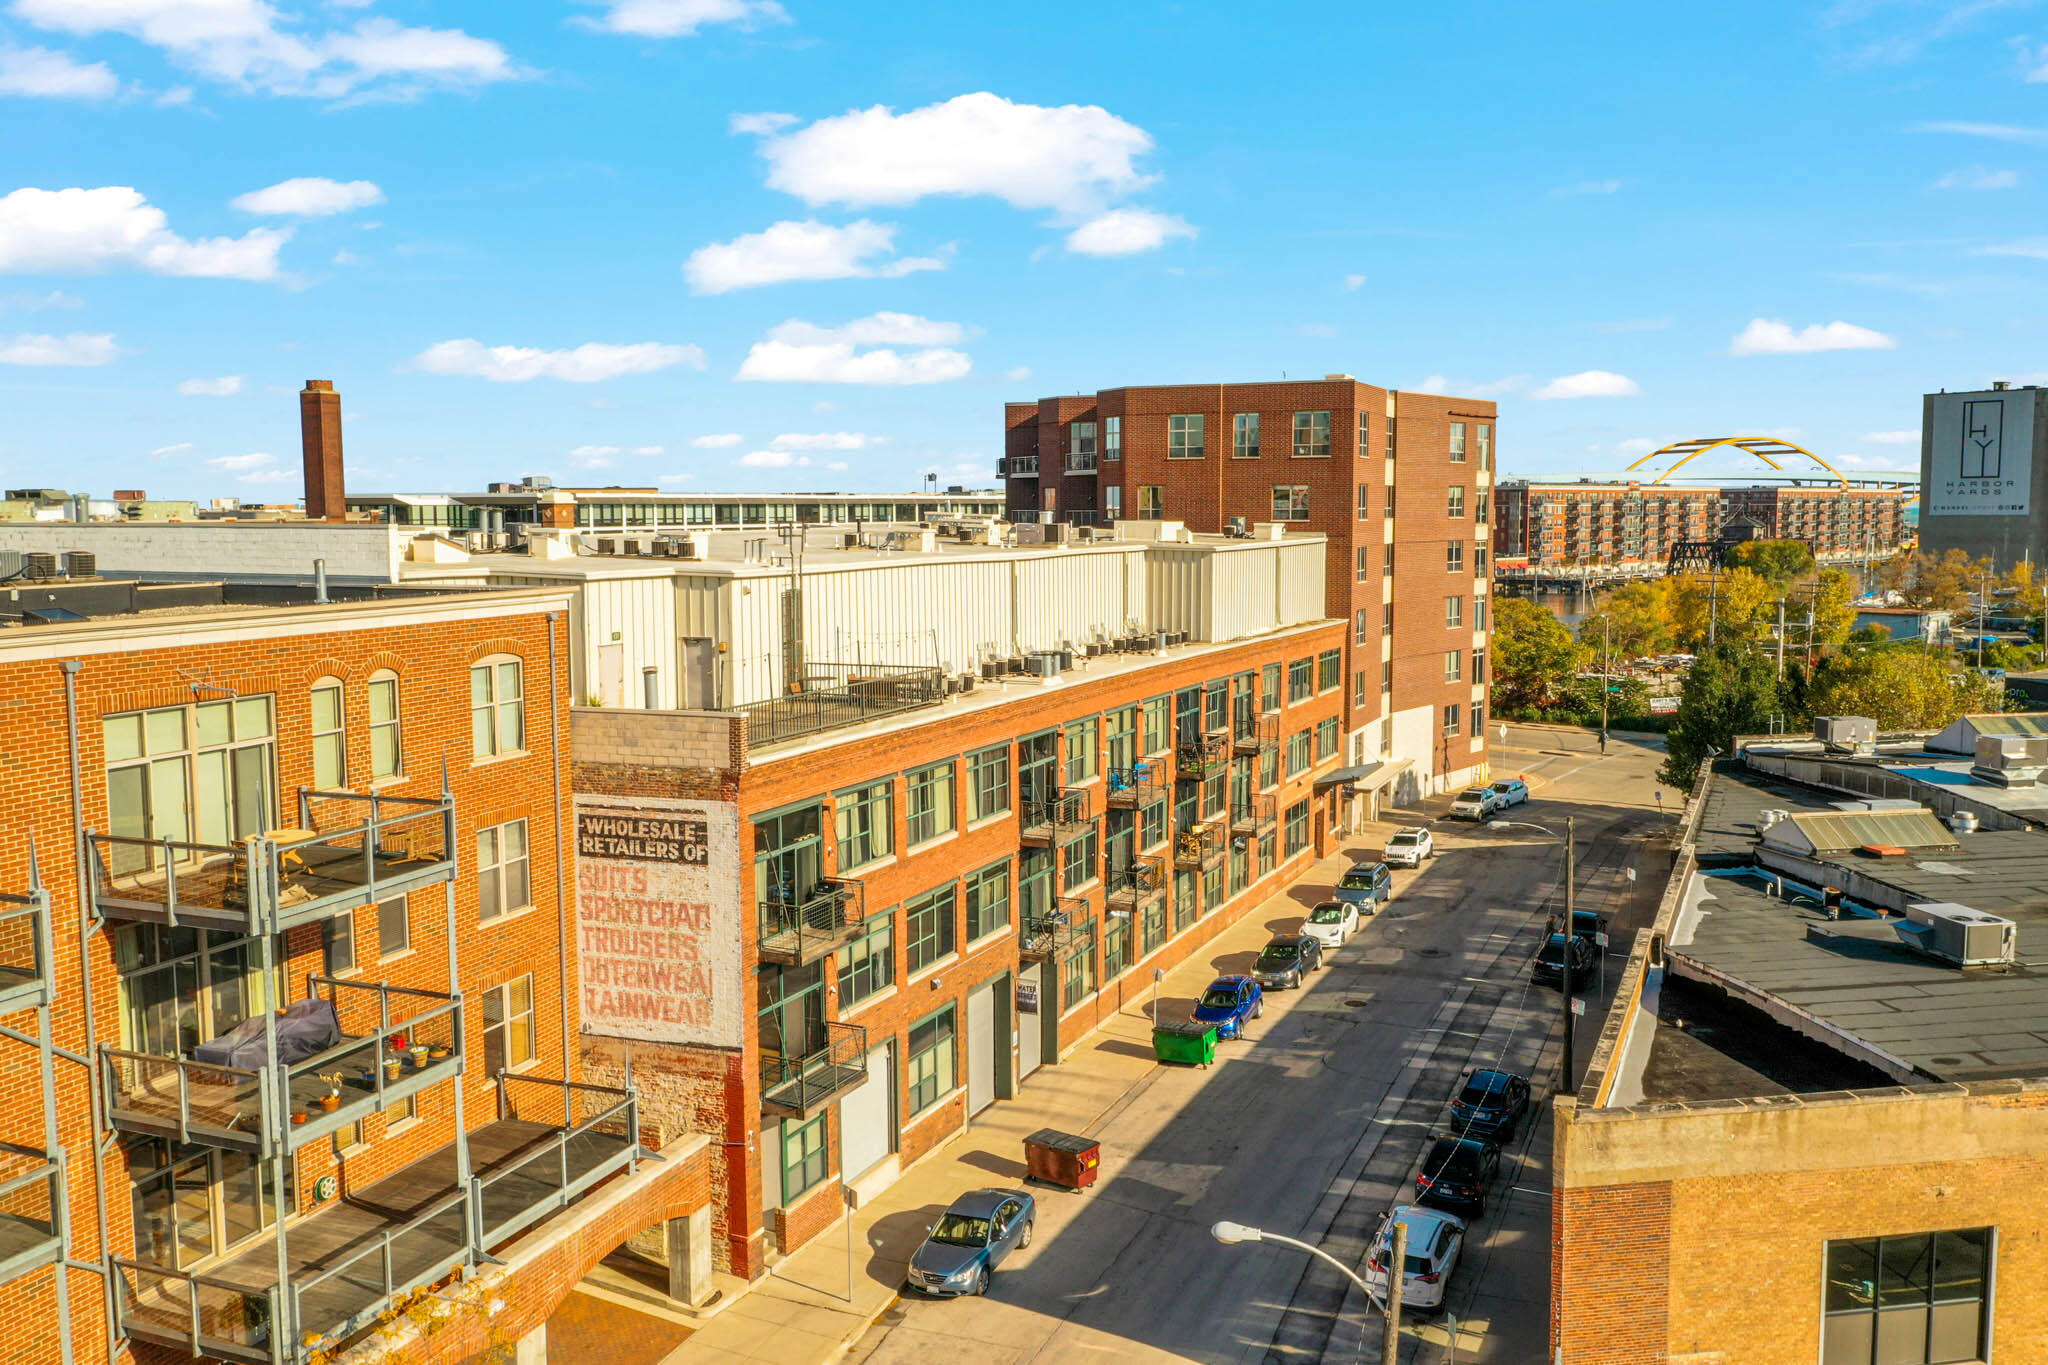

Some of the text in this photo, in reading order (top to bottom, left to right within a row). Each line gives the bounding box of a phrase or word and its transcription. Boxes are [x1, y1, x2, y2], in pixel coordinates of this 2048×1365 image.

[584, 817, 697, 841] WHOLESALE
[581, 836, 708, 861] RETAILERS OF
[580, 864, 648, 895] SUITS
[582, 925, 699, 962] TROUSERS
[582, 955, 713, 997] OUTERWEA
[1017, 984, 1036, 993] WATER
